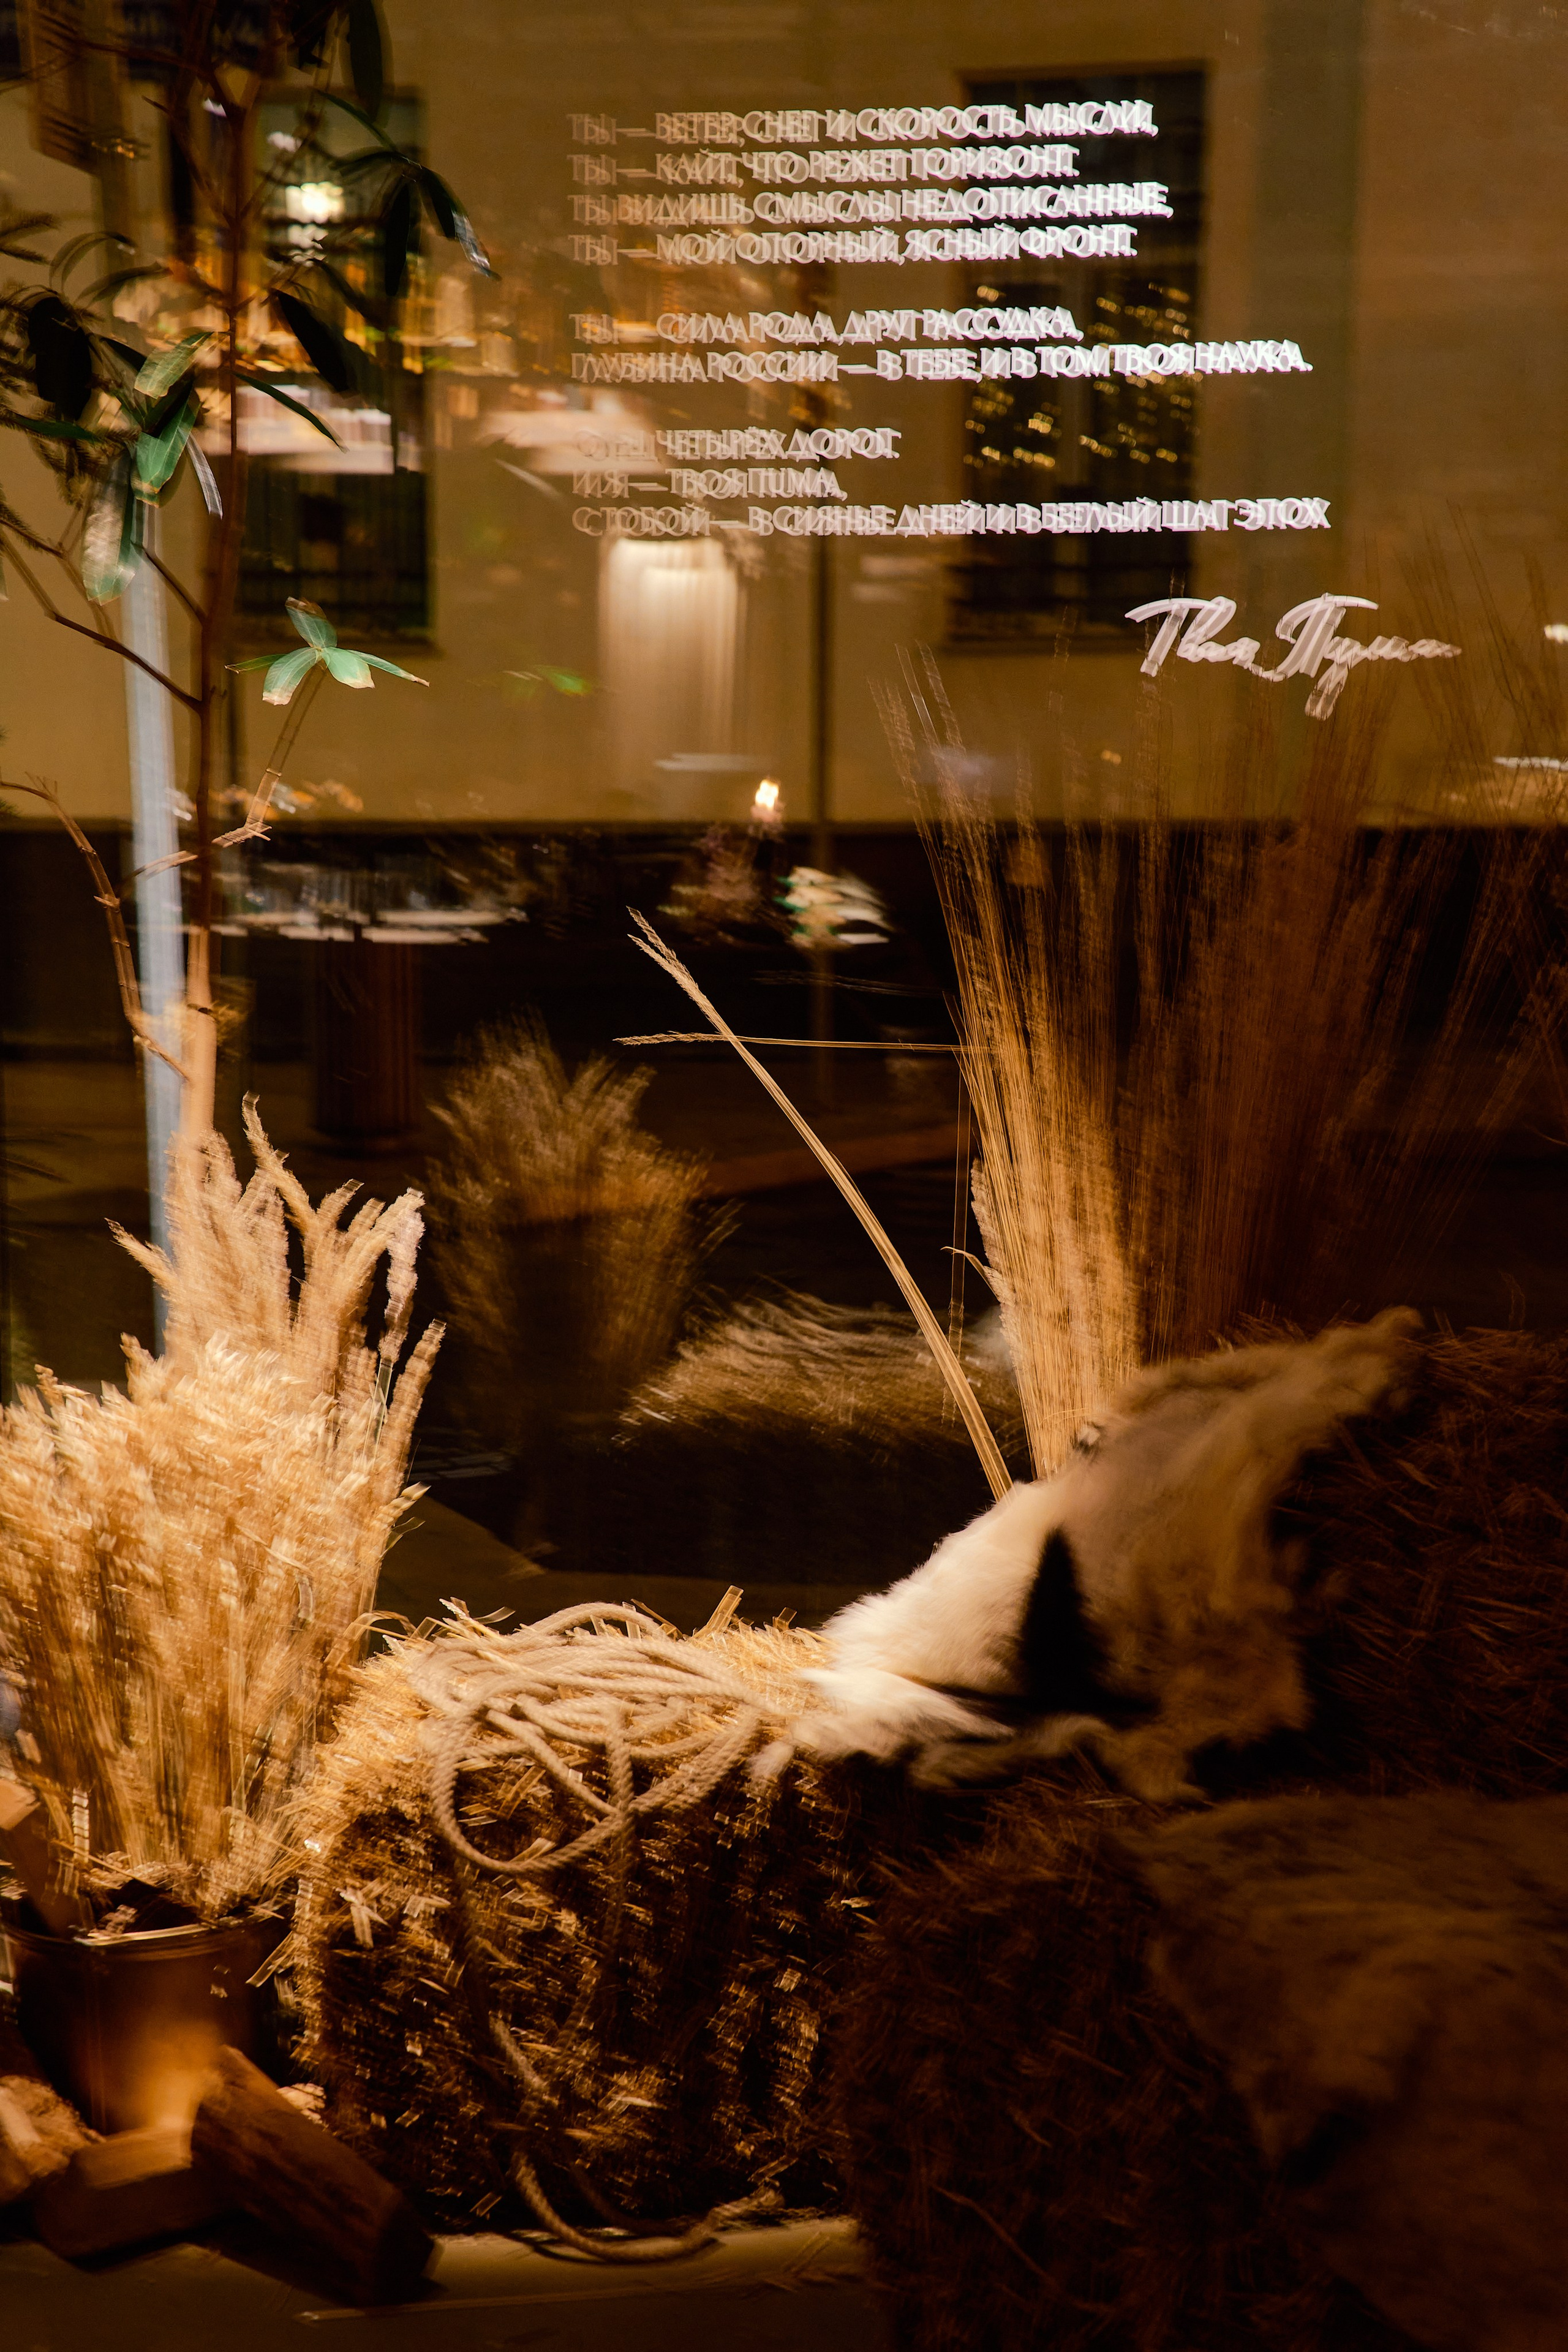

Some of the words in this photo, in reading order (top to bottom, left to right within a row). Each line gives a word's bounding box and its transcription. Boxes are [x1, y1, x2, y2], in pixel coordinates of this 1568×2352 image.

[566, 113, 617, 145] ТЫ
[825, 108, 858, 142] И
[856, 104, 1026, 141] СКОРОСТЬ
[1025, 99, 1159, 137] МЫСЛИ,
[566, 154, 617, 186] ТЫ
[741, 151, 809, 184] ЧТО
[809, 148, 913, 183] РЕЖЕТ
[911, 143, 1080, 181] ГОРИЗОНТ.
[567, 194, 617, 226] ТЫ
[617, 193, 755, 228] ВИДИШЬ
[753, 189, 902, 224] СМЫСЛЫ
[567, 234, 618, 265] ТЫ
[656, 228, 737, 265] МОЙ
[903, 222, 1021, 262] ЯСНЫЙ
[656, 312, 750, 344] СИЛА
[842, 309, 923, 344] ДРУГ
[571, 352, 709, 383] ГЛУБИНА
[707, 350, 839, 383] РОССИИ
[876, 349, 903, 381] В
[980, 347, 1012, 379] И
[1011, 346, 1038, 379] В
[1035, 345, 1111, 379] ТОМ
[1108, 343, 1196, 377] ТВОЯ
[1194, 339, 1313, 374] НАУКА.
[784, 427, 902, 462] ДОРОГ.
[665, 467, 748, 500] ТВОЯ
[601, 502, 710, 537] ТОБОЙ
[747, 505, 774, 536] В
[984, 503, 1017, 535] И
[1014, 502, 1042, 534] В
[1041, 496, 1163, 533] БЕЛЫЙ
[1161, 499, 1238, 532] ШАГ
